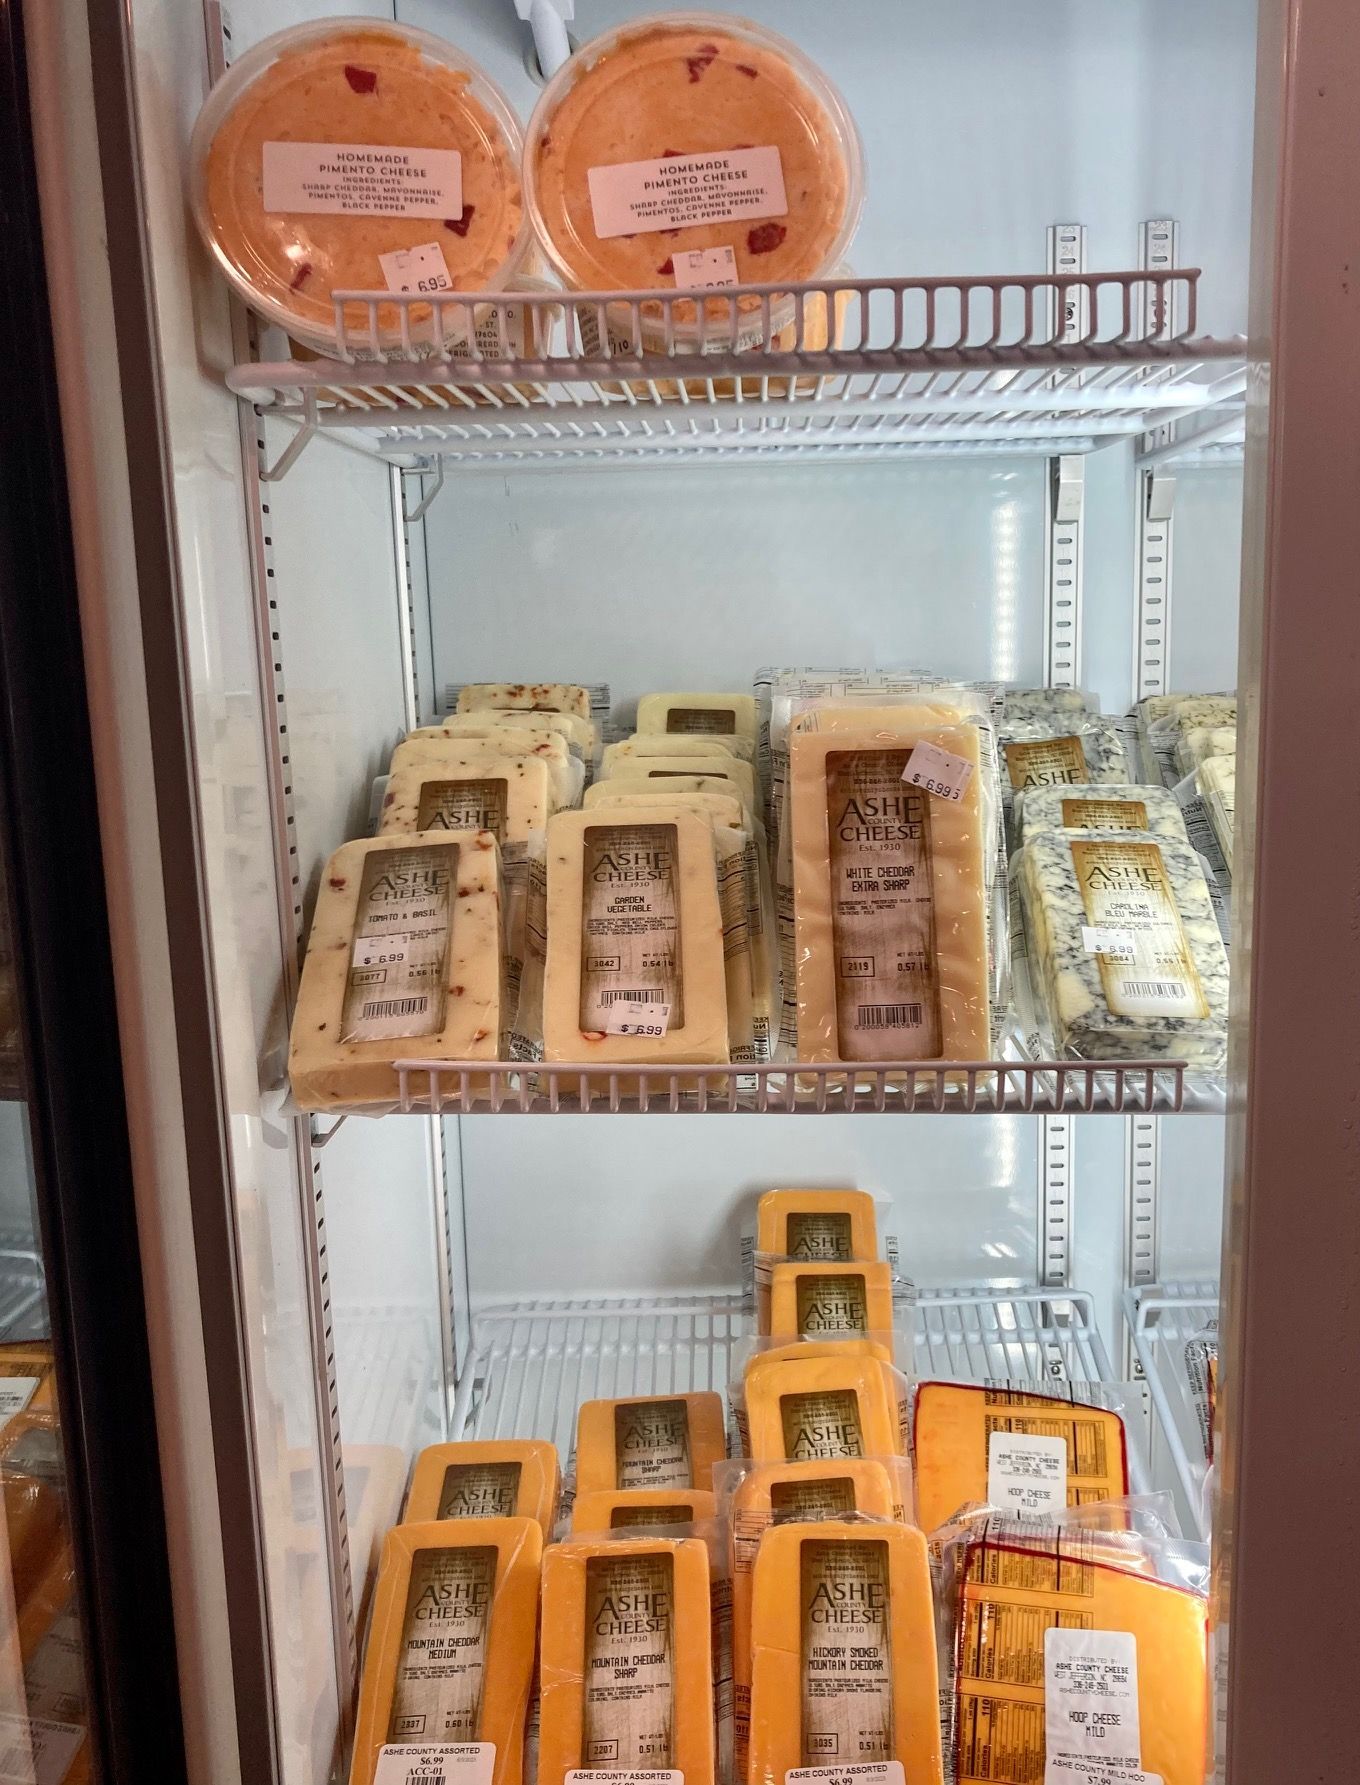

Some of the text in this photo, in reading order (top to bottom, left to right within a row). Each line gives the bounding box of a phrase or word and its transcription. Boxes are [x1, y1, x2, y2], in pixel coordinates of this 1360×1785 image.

[337, 153, 409, 165] HOMEMADE
[319, 164, 427, 178] PIMENTO CHEESE
[659, 160, 730, 175] HOMEMADE
[644, 170, 748, 190] PIMENTO CHEESE
[302, 183, 331, 191] SHARP
[334, 185, 379, 193] CHEDDAR,
[309, 192, 353, 200] PIMENTOS,
[373, 203, 405, 211] PEPPER
[629, 201, 658, 211] SHARP
[661, 196, 704, 207] CHEDDAR,
[637, 207, 683, 218] PIMENTOS,
[670, 209, 732, 222] BLACK PEPPER
[912, 773, 952, 797] $ 6.99
[837, 796, 923, 828] ASHE
[425, 810, 499, 830] ASHE
[840, 825, 920, 842] CHEESE
[880, 843, 900, 851] 1930
[591, 852, 671, 873] ASHE
[593, 870, 669, 882] CHEESE
[846, 866, 915, 879] WHITE CHEDDAR
[1085, 866, 1162, 882] ASHE
[369, 869, 449, 893] ASHE
[852, 879, 910, 892] EXTRA SHARP
[1089, 881, 1162, 891] CHEESE
[369, 887, 446, 901] CHEESE
[614, 896, 645, 904] GARDEN
[607, 904, 652, 913] VEGETABLE
[1109, 902, 1148, 910] CAROLINA
[368, 913, 399, 923] TOMATO
[413, 909, 438, 919] BASIL
[1109, 945, 1133, 953] 6.99
[379, 953, 404, 964] 6.99
[897, 962, 915, 971] 0.57
[621, 1024, 663, 1035] $ 6.99
[793, 1237, 848, 1253] ASHE
[804, 1302, 863, 1321] ASHE
[806, 1320, 861, 1330] CHEESE
[624, 1422, 685, 1441] ASHE
[792, 1424, 858, 1451] ASHE
[795, 1445, 858, 1459] CHEESE
[446, 1488, 512, 1507] ASHE
[1008, 1487, 1052, 1499] HOOP CHEESE
[1021, 1498, 1038, 1507] MILD
[447, 1504, 511, 1515] CHEESE
[414, 1582, 488, 1608] ASHE
[809, 1583, 885, 1609] ASHE
[415, 1605, 484, 1620] CHEESE
[594, 1593, 668, 1622] ASHE
[811, 1609, 883, 1624] CHEESE
[595, 1619, 666, 1636] CHEESE
[407, 1636, 480, 1649] MOUNTAIN CHEDDAR
[428, 1649, 456, 1659] MEDIUM
[813, 1647, 878, 1658] HICKORY SMOKED
[591, 1654, 665, 1668] MOUNTAIN CHEDDAR
[808, 1659, 884, 1671] MOUNTAIN CHEDDAR
[614, 1668, 638, 1679] SHARP
[1056, 1663, 1128, 1674] ASHE COUNTY CHEESE
[982, 1699, 990, 1716] 110
[401, 1720, 420, 1728] 2337
[1068, 1711, 1121, 1725] HOOP CHEESE
[1085, 1726, 1105, 1738] MILD
[383, 1748, 404, 1756] ASHE
[406, 1747, 437, 1755] COUNTY
[594, 1745, 613, 1754] 2207
[639, 1745, 655, 1754] 0.51
[859, 1741, 875, 1750] 0.51
[420, 1757, 444, 1765] $6.99
[407, 1767, 443, 1775] ACC-01
[790, 1765, 888, 1778] ASHE COUNTY ASSORTED
[1052, 1759, 1145, 1783] ASHE COUNTY MILD HOO
[1088, 1776, 1111, 1785] $7.99
